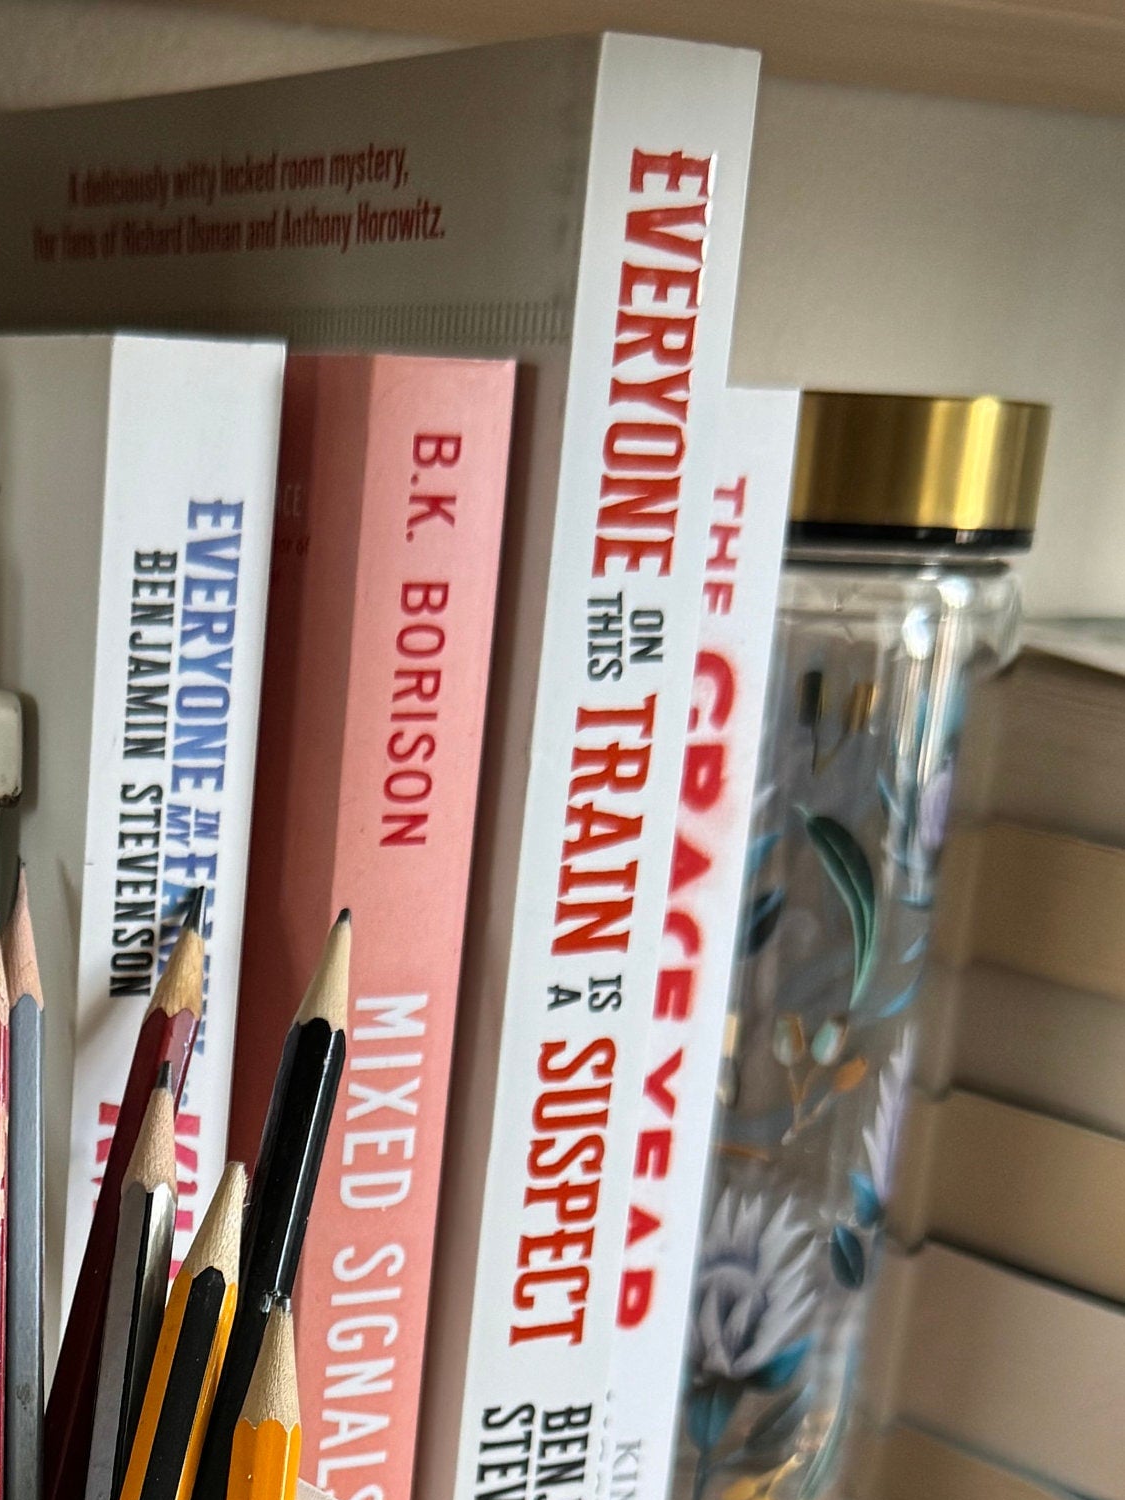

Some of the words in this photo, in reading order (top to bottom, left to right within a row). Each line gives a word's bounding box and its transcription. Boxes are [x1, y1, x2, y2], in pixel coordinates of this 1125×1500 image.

[245, 208, 276, 250] and
[280, 203, 352, 253] Anthony
[356, 197, 446, 245] Horowitz.
[280, 153, 324, 193] room
[328, 143, 410, 194] mystery,
[591, 147, 715, 579] EVERYONE
[405, 431, 463, 544] B.K.
[123, 549, 178, 761] BENJAMIN
[171, 498, 245, 793] EVERYONE
[586, 591, 624, 683] THIS
[629, 608, 665, 664] ON
[379, 581, 451, 848] BORISON
[164, 801, 196, 851] MY
[193, 804, 221, 841] IN
[551, 692, 658, 956] TRAIN
[109, 783, 164, 999] STEVENSON
[546, 983, 582, 1012] A
[587, 973, 623, 1013] IS
[338, 992, 429, 1213] MIXED
[508, 1036, 617, 1347] SUSPECT
